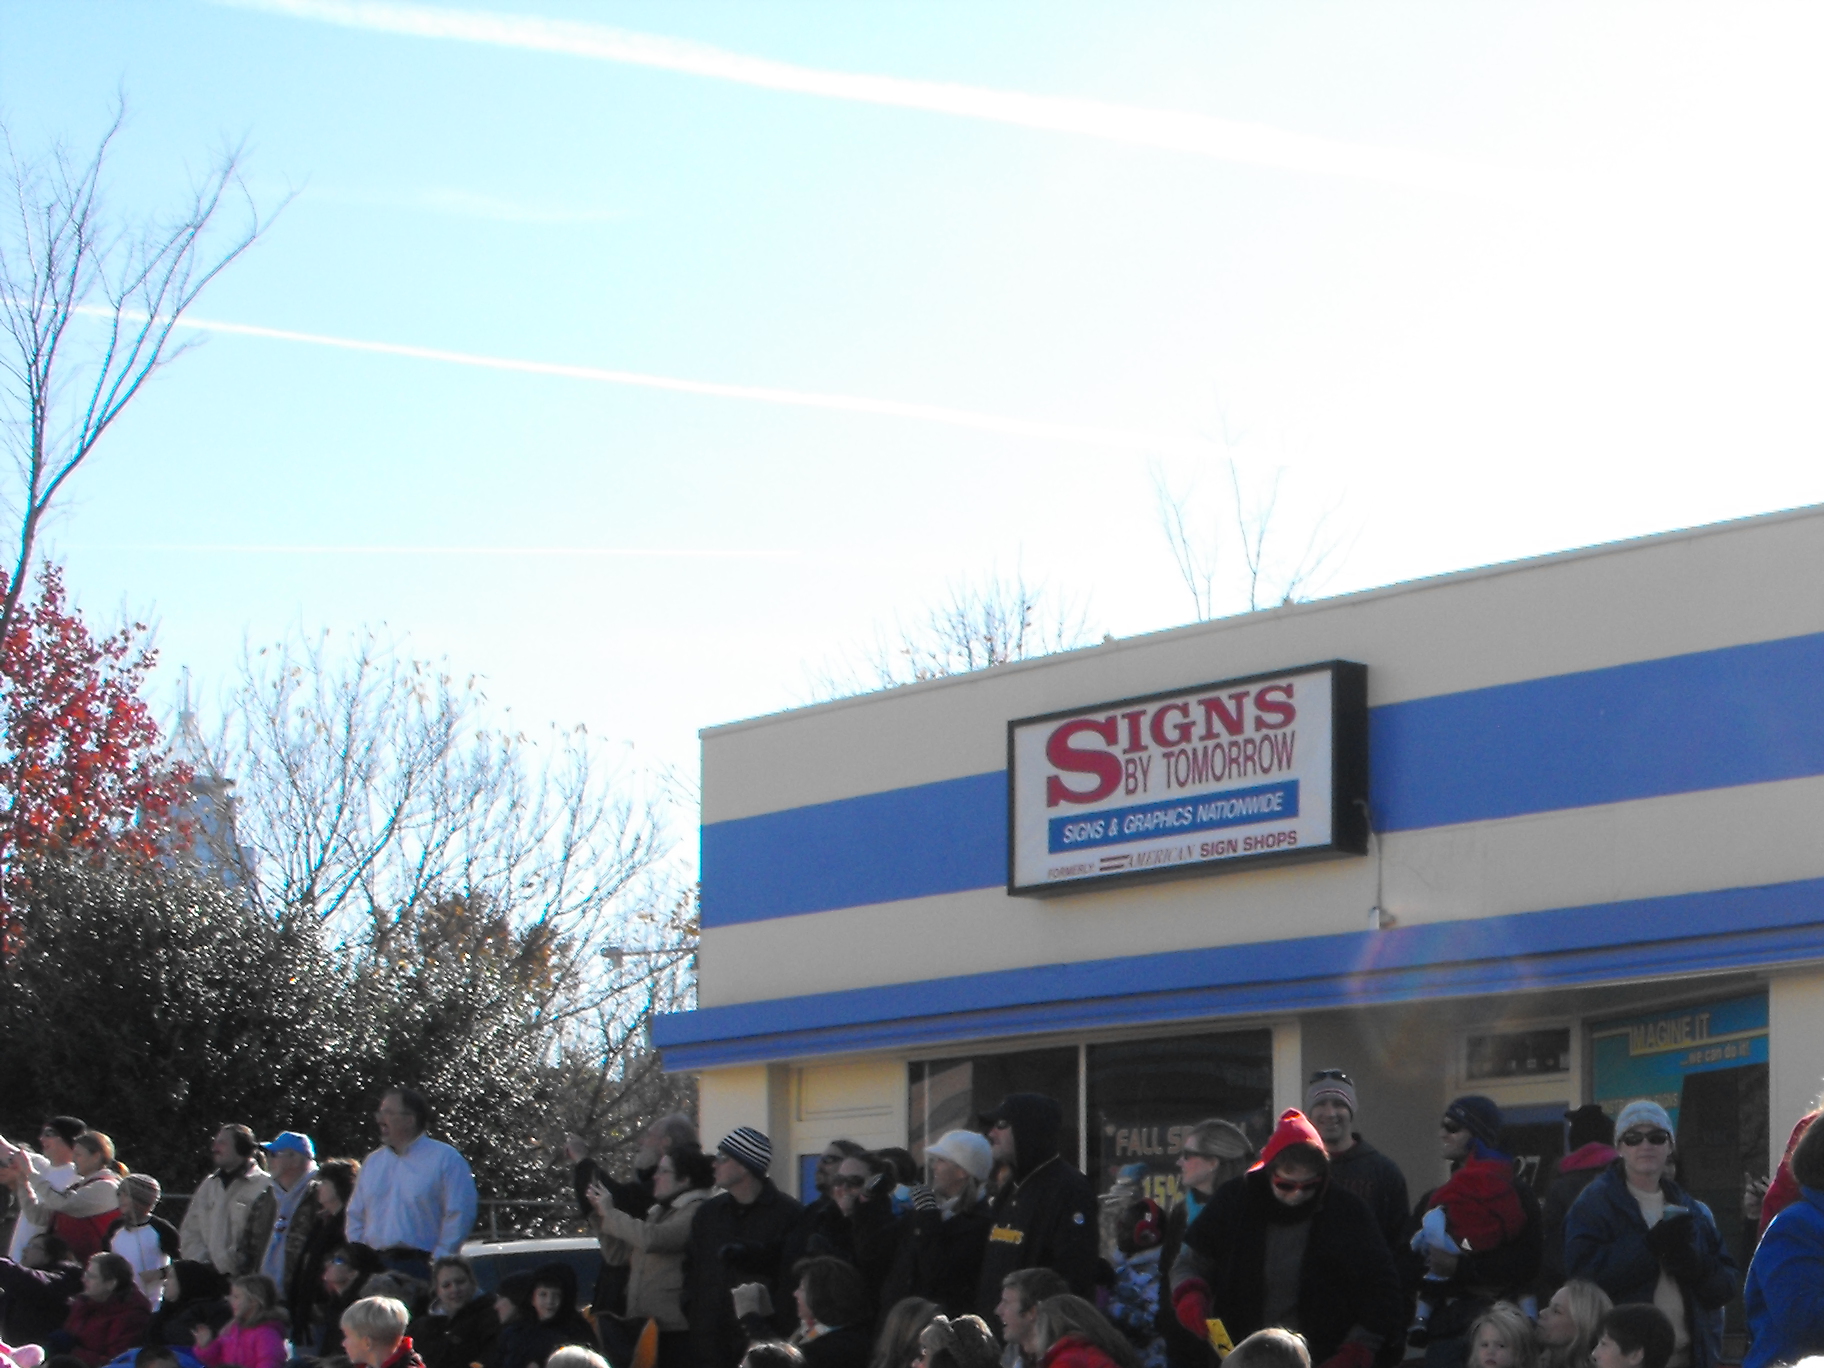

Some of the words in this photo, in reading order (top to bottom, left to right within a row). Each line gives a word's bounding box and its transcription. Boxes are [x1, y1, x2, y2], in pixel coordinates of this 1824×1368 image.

[1045, 683, 1297, 809] SIGNS
[1124, 754, 1152, 796] BY
[1162, 730, 1296, 790] TOMORROW
[1062, 819, 1105, 844] SIGNS
[1108, 817, 1119, 837] &
[1124, 805, 1193, 834] GRAPHICS
[1197, 791, 1286, 825] NATIONWIDE
[1200, 839, 1238, 859] SIGN
[1243, 830, 1298, 851] SHOPS
[1116, 1127, 1163, 1156] FALL
